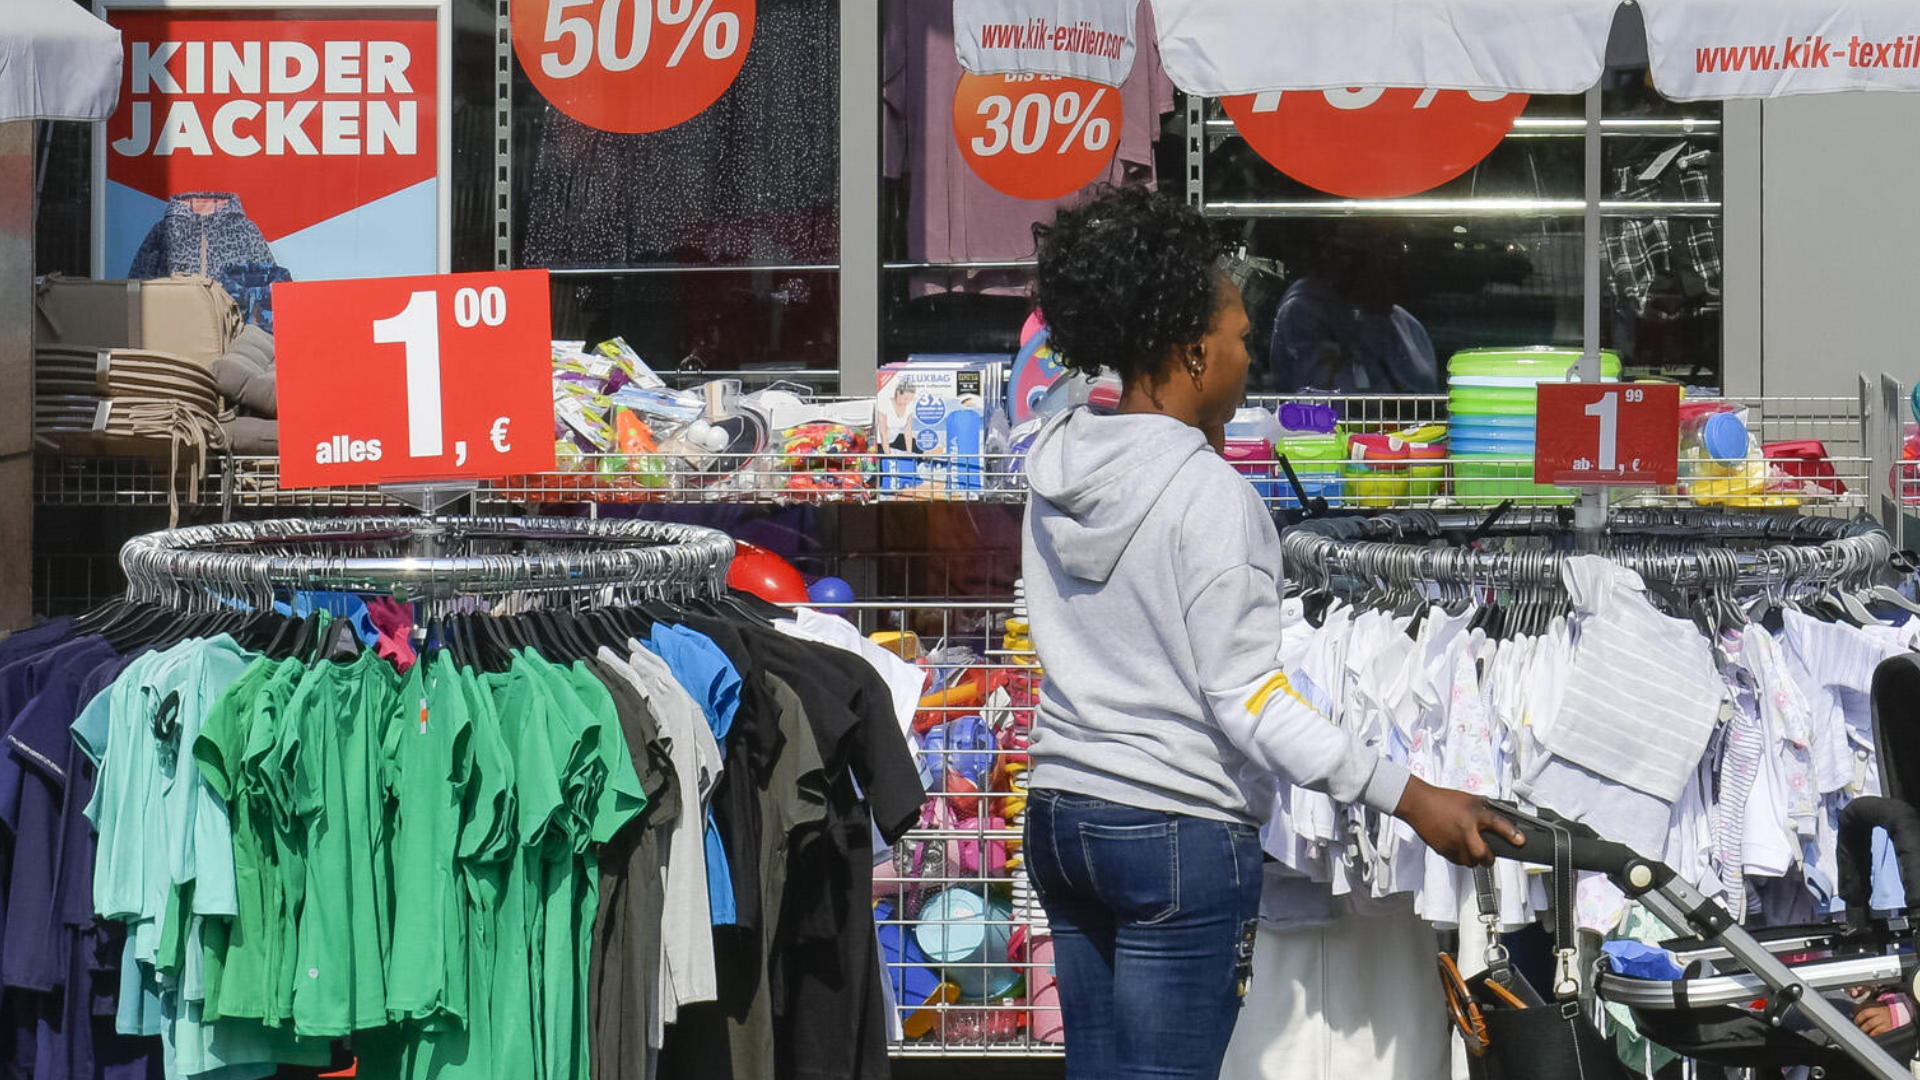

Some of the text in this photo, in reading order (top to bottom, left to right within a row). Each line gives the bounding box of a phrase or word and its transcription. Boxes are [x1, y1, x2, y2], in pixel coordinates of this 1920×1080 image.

[540, 0, 740, 79] 50%
[131, 41, 414, 95] KINDER
[111, 100, 418, 157] JACKEN
[971, 88, 1111, 157] 30%
[1625, 388, 1644, 402] 99
[315, 434, 383, 465] alles
[490, 417, 511, 454] €
[1572, 457, 1591, 470] ab
[1632, 457, 1641, 472] €
